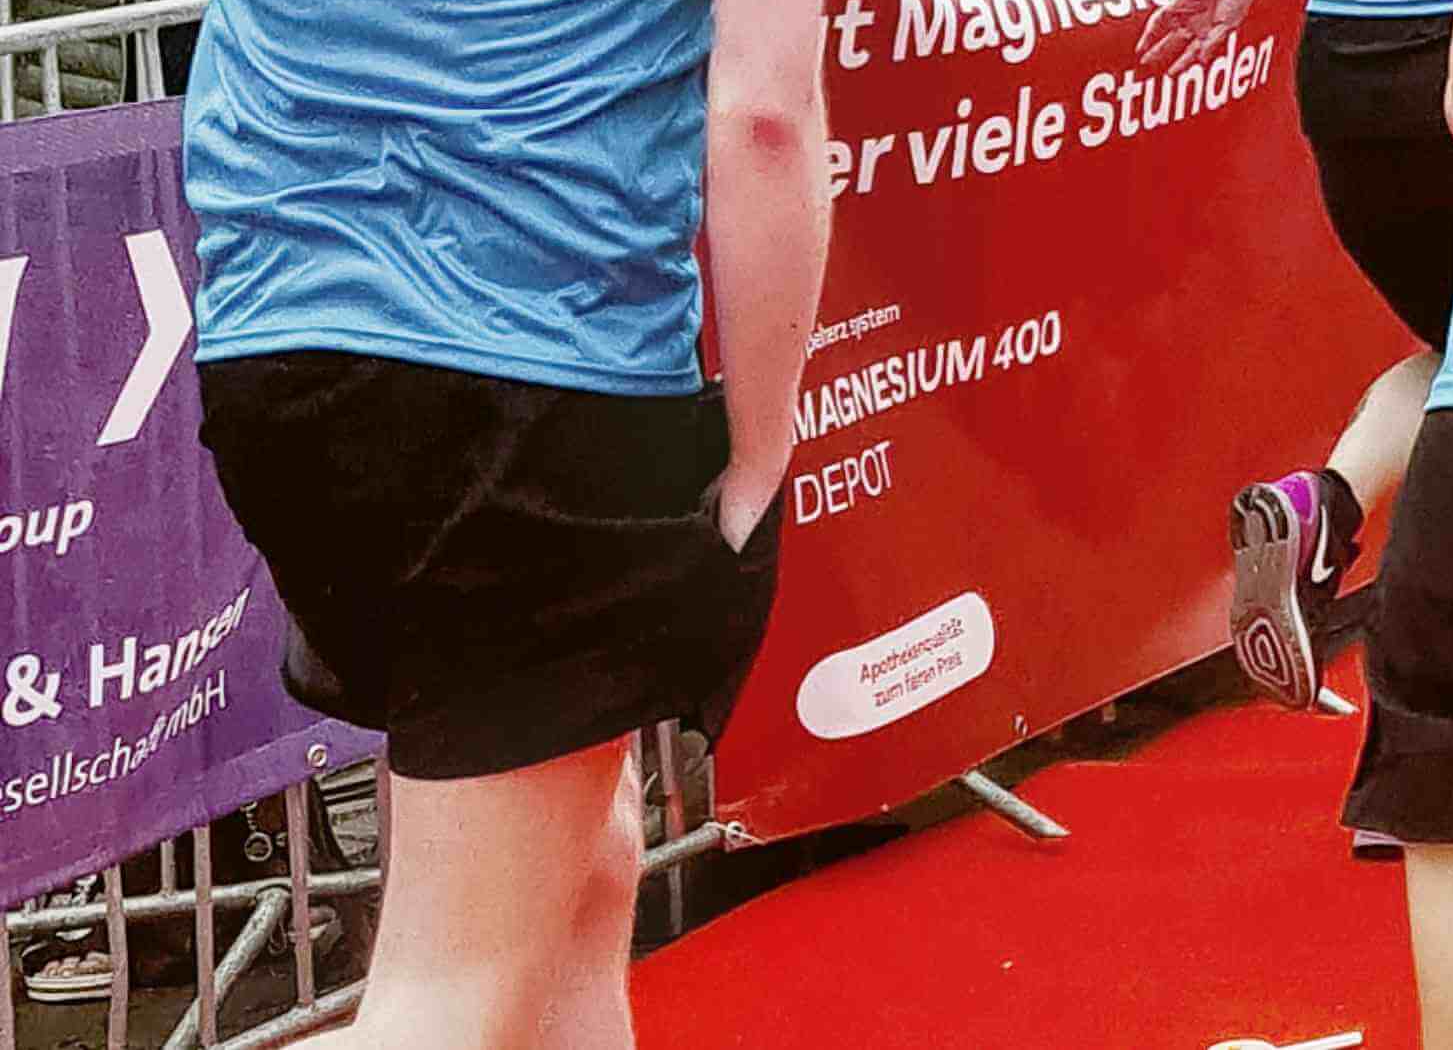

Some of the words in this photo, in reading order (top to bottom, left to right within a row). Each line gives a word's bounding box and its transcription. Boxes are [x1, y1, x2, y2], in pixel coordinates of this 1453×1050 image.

[906, 86, 1067, 186] viele
[1078, 31, 1275, 149] Stunden
[791, 335, 987, 446] MAGNESIUM
[992, 310, 1062, 371] 400
[793, 440, 892, 525] DEPOT
[1, 652, 63, 727] &
[88, 587, 251, 709] Hansen
